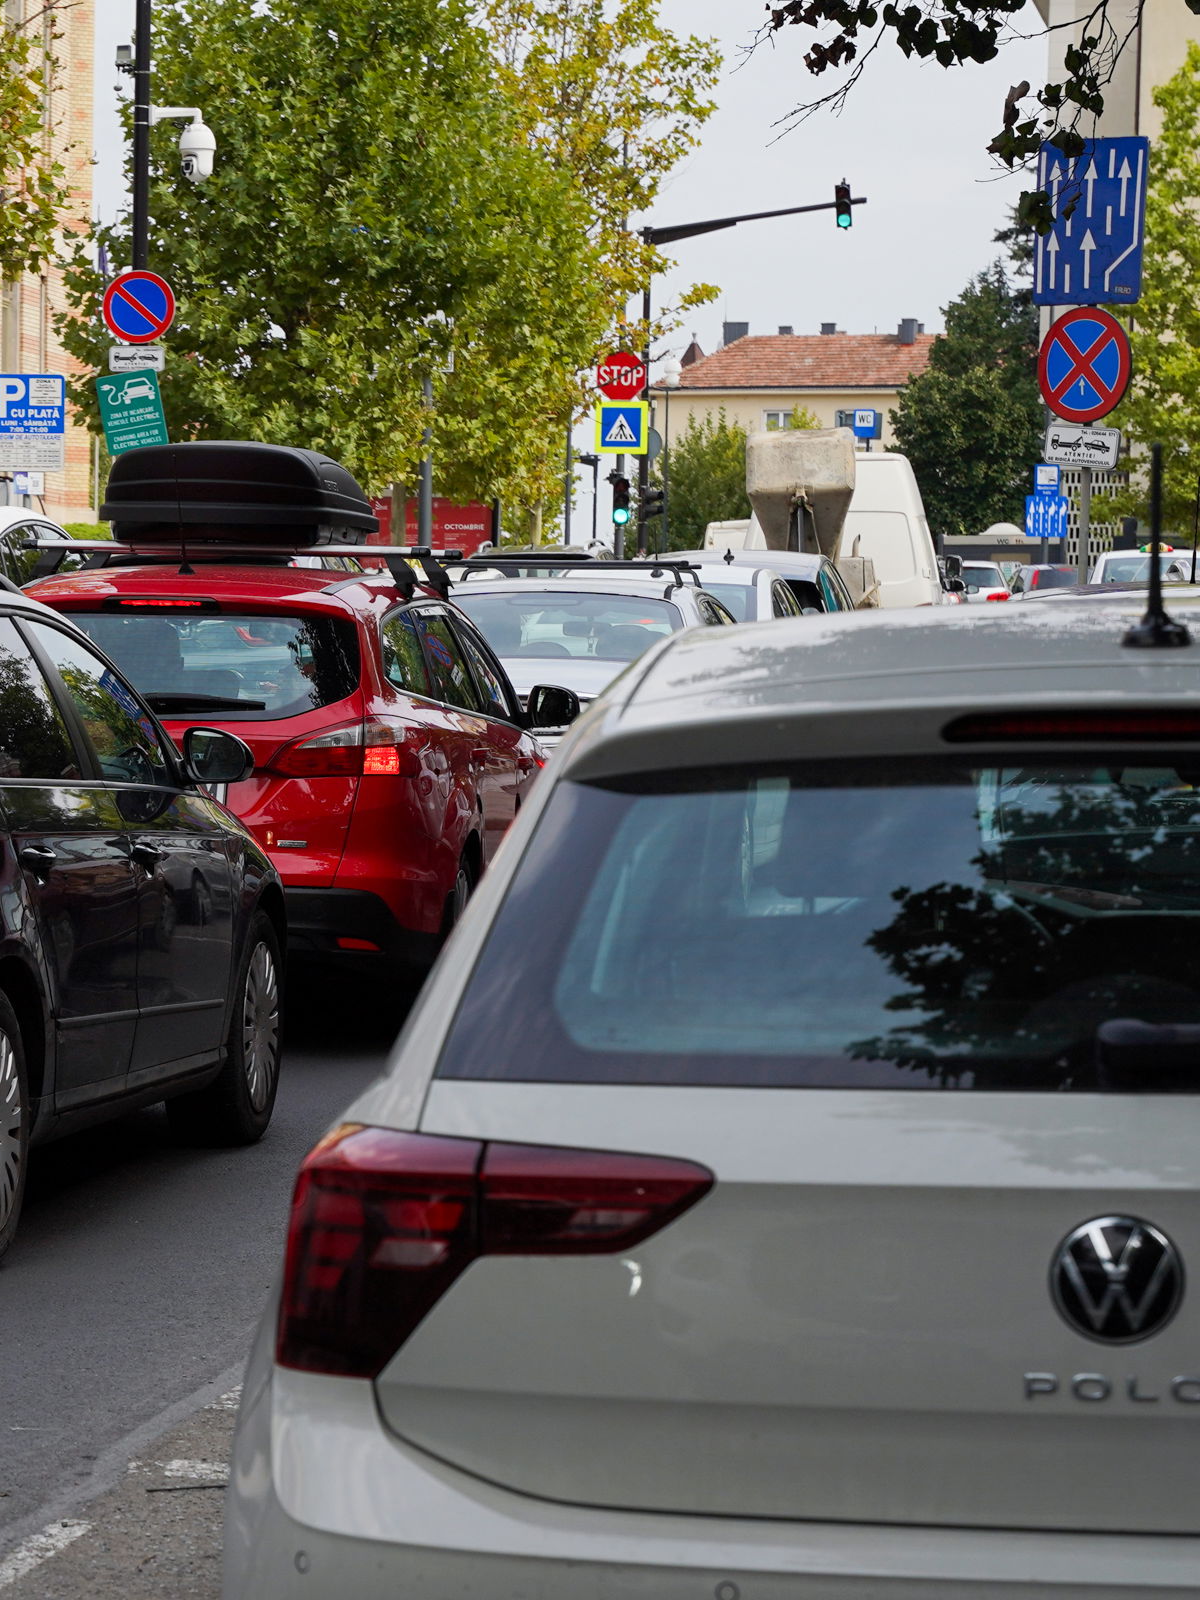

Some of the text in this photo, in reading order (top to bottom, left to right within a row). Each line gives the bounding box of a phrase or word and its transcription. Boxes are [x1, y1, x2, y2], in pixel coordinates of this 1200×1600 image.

[599, 365, 644, 386] STOP
[11, 406, 60, 418] CU PLATĂ
[130, 412, 160, 423] ELECTRICE
[859, 414, 871, 423] WC
[113, 433, 136, 442] CHARGING
[113, 436, 162, 449] ELECTRIC VEHICLES
[444, 523, 485, 531] OCTOMBRIE
